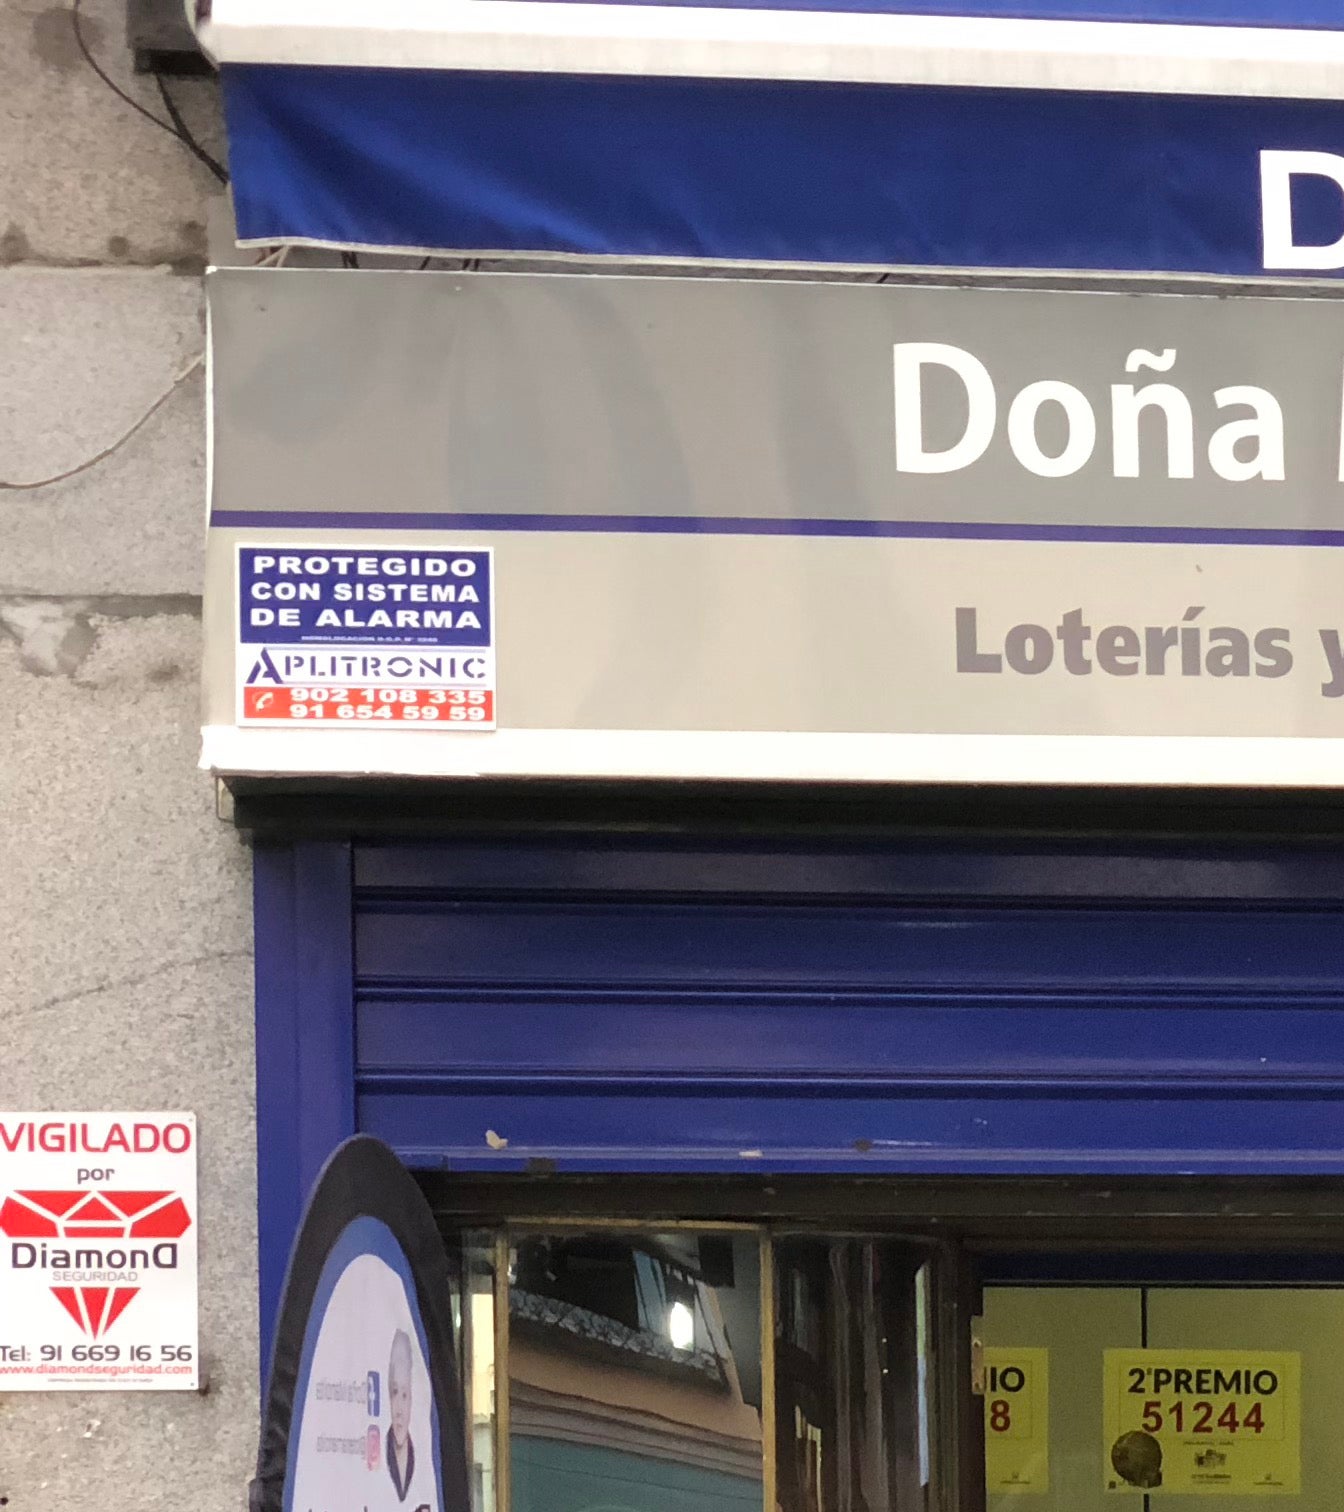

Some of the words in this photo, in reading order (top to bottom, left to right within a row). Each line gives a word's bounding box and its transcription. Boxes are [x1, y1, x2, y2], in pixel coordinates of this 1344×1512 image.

[893, 342, 1285, 481] Doña
[253, 556, 476, 577] PROTEGIDO
[251, 582, 320, 601] CON
[333, 583, 480, 603] SISTEMA
[251, 608, 301, 626] DE
[315, 608, 481, 629] ALARMA
[955, 606, 1293, 679] Loterías
[246, 647, 486, 684] APLITRONIC
[290, 688, 349, 703] 902
[360, 690, 418, 704] 108
[428, 690, 486, 705] 335
[290, 704, 325, 718] 91
[336, 705, 393, 719] 654
[402, 705, 439, 720] 59
[449, 706, 486, 721] 59
[0, 1122, 192, 1154] VIGILADO
[77, 1167, 115, 1185] por
[52, 1270, 139, 1282] SEGURIDAD
[40, 1345, 62, 1362] 91
[71, 1344, 121, 1362] 669
[130, 1345, 152, 1362] 16
[160, 1344, 193, 1362] 56
[1155, 1369, 1279, 1396] PREMIO
[1141, 1400, 1266, 1435] 51244
